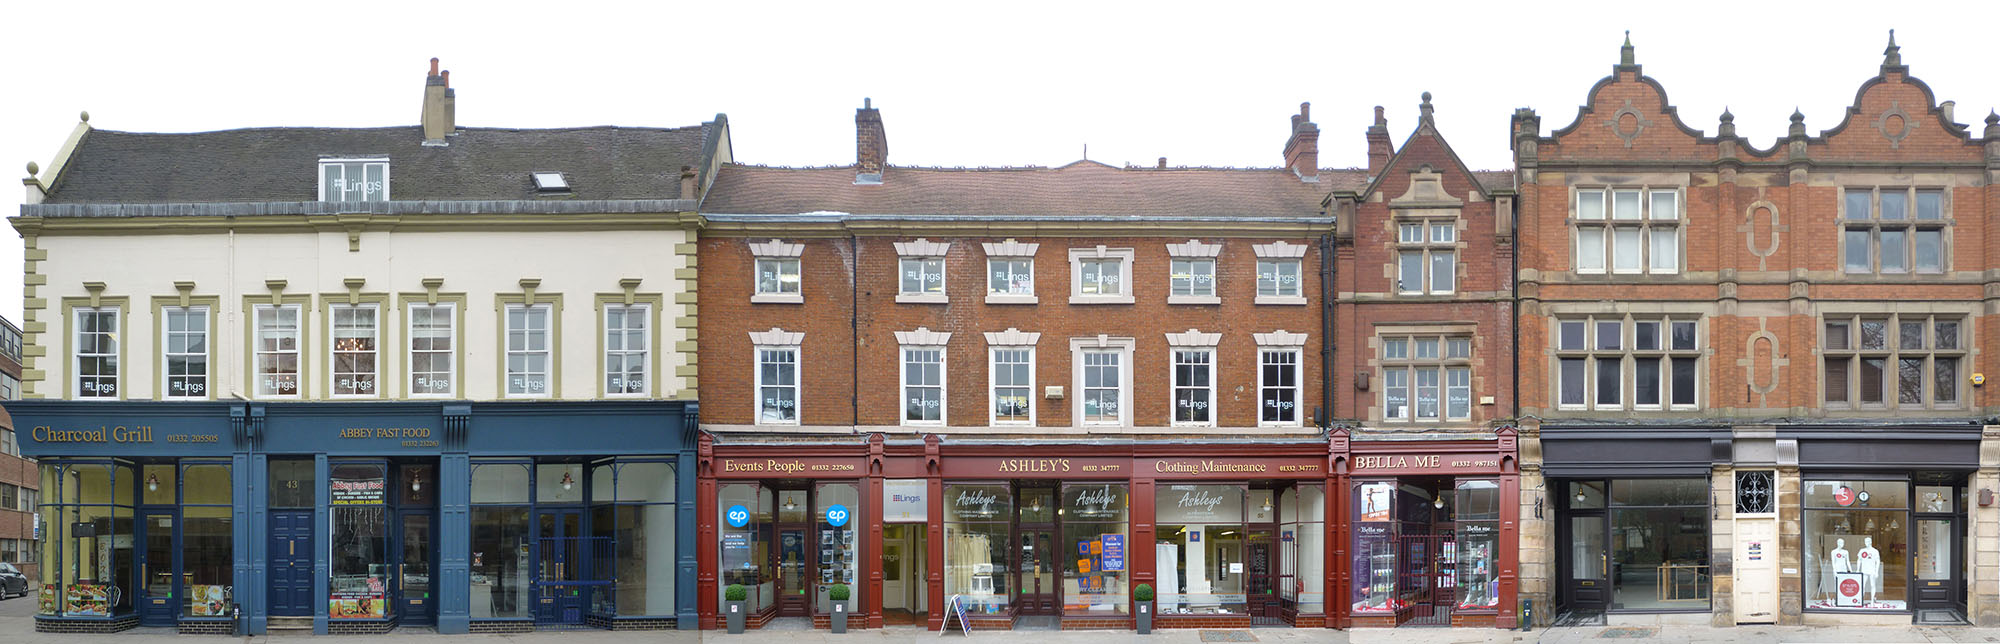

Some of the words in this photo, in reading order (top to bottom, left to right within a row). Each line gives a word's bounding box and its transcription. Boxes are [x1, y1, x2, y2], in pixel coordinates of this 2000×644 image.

[344, 178, 382, 194] Lings
[619, 378, 642, 390] Lngs
[32, 426, 107, 442] Charcoal
[112, 426, 153, 442] Grill
[339, 428, 374, 438] ABBEY
[376, 428, 400, 438] FAST
[402, 428, 431, 438] FOOD
[725, 459, 764, 472] Events
[767, 459, 806, 474] People
[998, 458, 1071, 473] ASHLEY'S
[1155, 460, 1199, 475] Clothing
[1201, 460, 1266, 473] Maintenance
[1355, 456, 1408, 469] BELLA
[1415, 455, 1441, 468] ME
[900, 495, 921, 504] Lings
[955, 489, 997, 511] Ashleys
[1075, 489, 1117, 510] Ashleys
[1177, 490, 1223, 512] Ashleys
[729, 511, 747, 523] ep
[829, 510, 846, 522] ep
